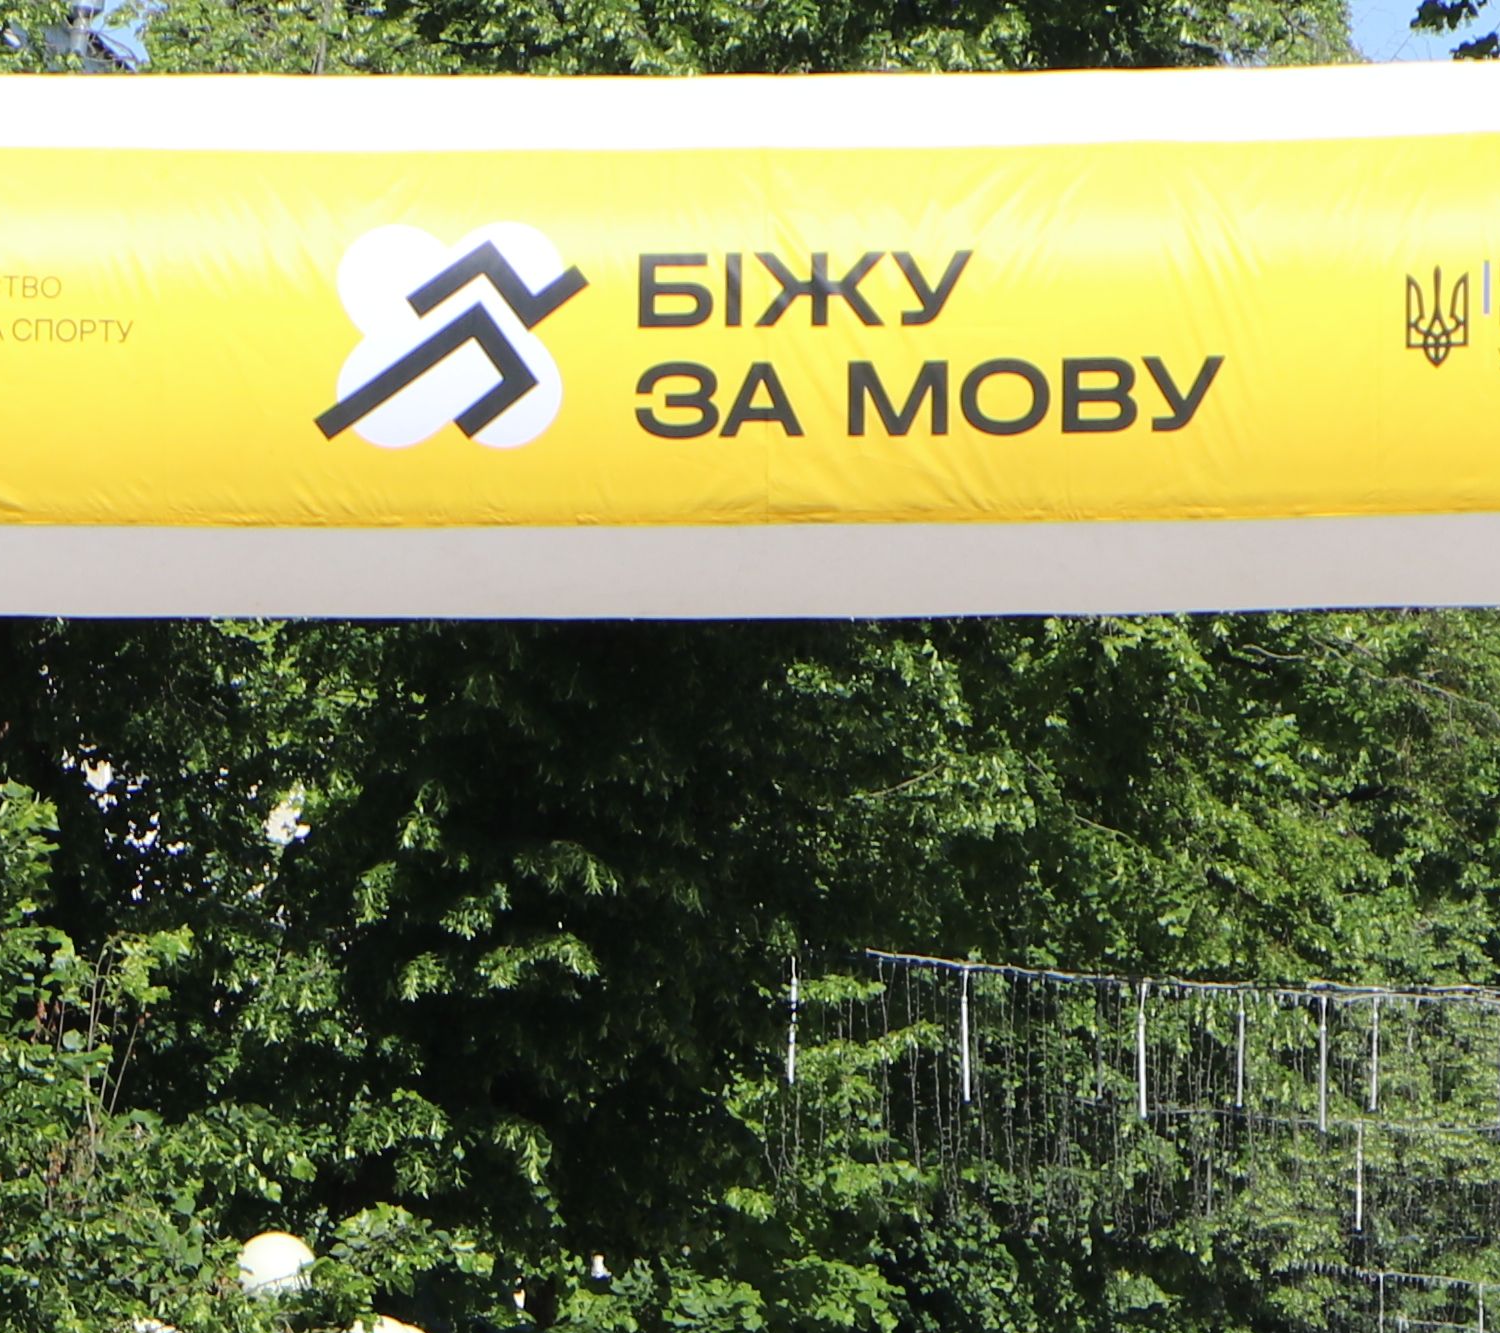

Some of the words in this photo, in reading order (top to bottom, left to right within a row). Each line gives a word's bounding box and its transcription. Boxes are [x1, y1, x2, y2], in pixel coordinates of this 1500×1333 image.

[636, 248, 973, 329] БІЖУ
[11, 318, 135, 343] СПОРТУ
[633, 360, 804, 440] ЗА
[846, 355, 1225, 438] МОВУ
